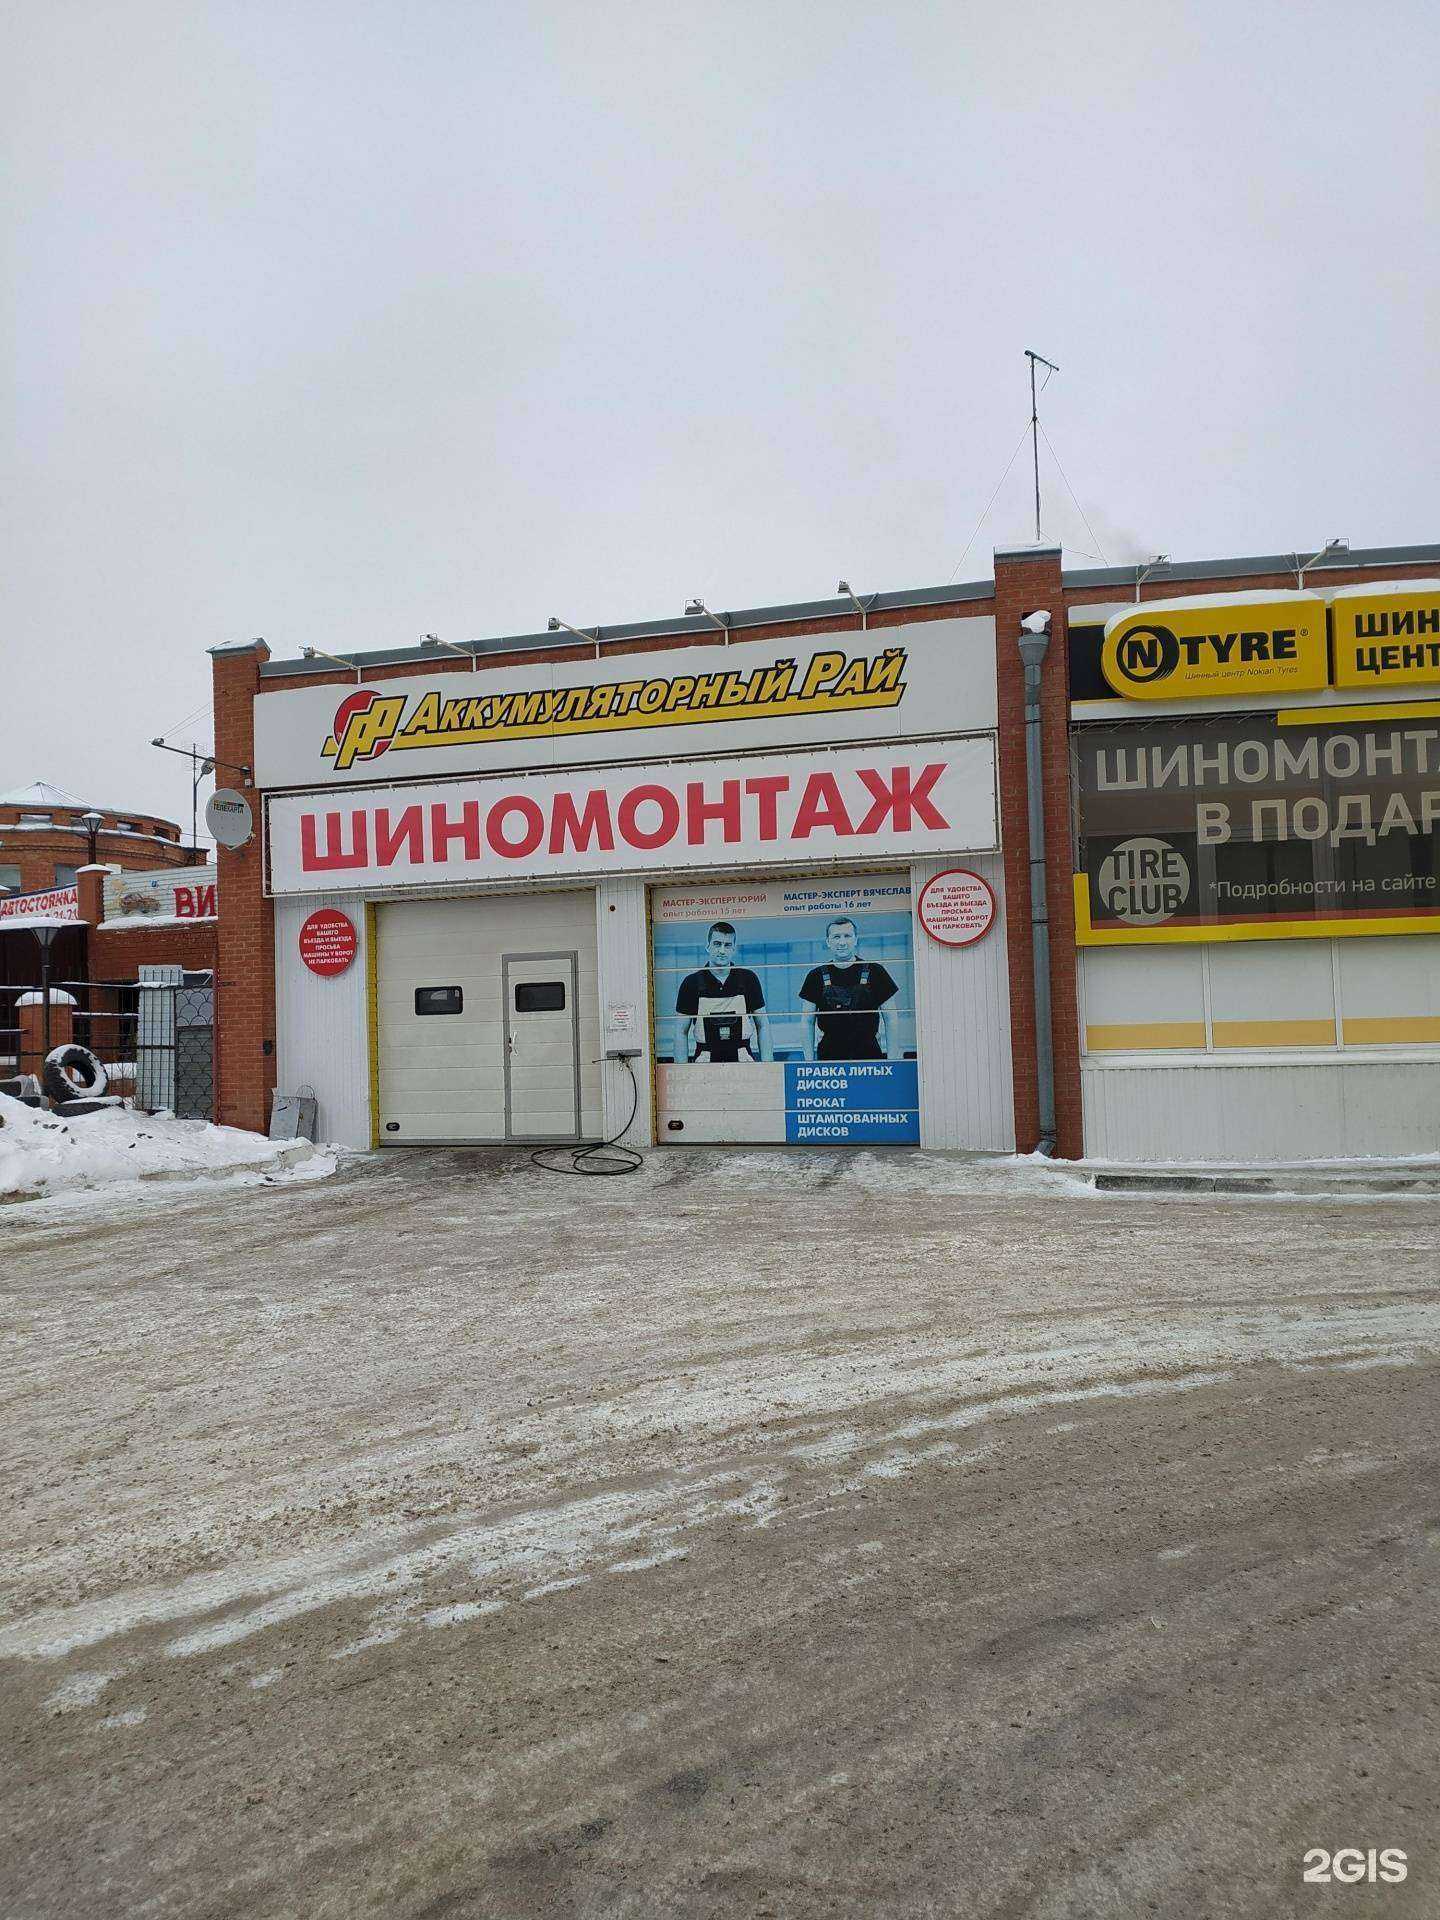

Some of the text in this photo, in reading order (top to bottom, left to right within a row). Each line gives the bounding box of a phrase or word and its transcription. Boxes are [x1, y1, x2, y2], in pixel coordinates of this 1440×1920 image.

[1355, 609, 1440, 637] ШИН
[1247, 667, 1274, 676] Nokian
[1096, 730, 1440, 792] ШИНОМОНТ
[300, 763, 951, 872] ШИНОМОНТАЖ
[1197, 802, 1231, 845] В
[1107, 849, 1181, 880] TIRE
[1352, 879, 1375, 892] на
[1382, 873, 1436, 891] сайте
[663, 893, 767, 907] МАСТЕР-ЭКСПЕРТ ЮРИЙ
[784, 887, 911, 900] МАСТЕР-ЭКСПЕРТ ВЯЧЕСЛАВ
[784, 904, 806, 912] опыт
[808, 901, 841, 912] работы
[844, 900, 854, 909] 16
[797, 1065, 893, 1077] ПРАВКА ЛИТЫХ
[797, 1079, 848, 1091] ДИСКОВ
[797, 1097, 846, 1108] ПРОКАТ
[797, 1113, 908, 1124] ШТАМПОВАННЫХ
[797, 1126, 849, 1138] ДИСКОВ
